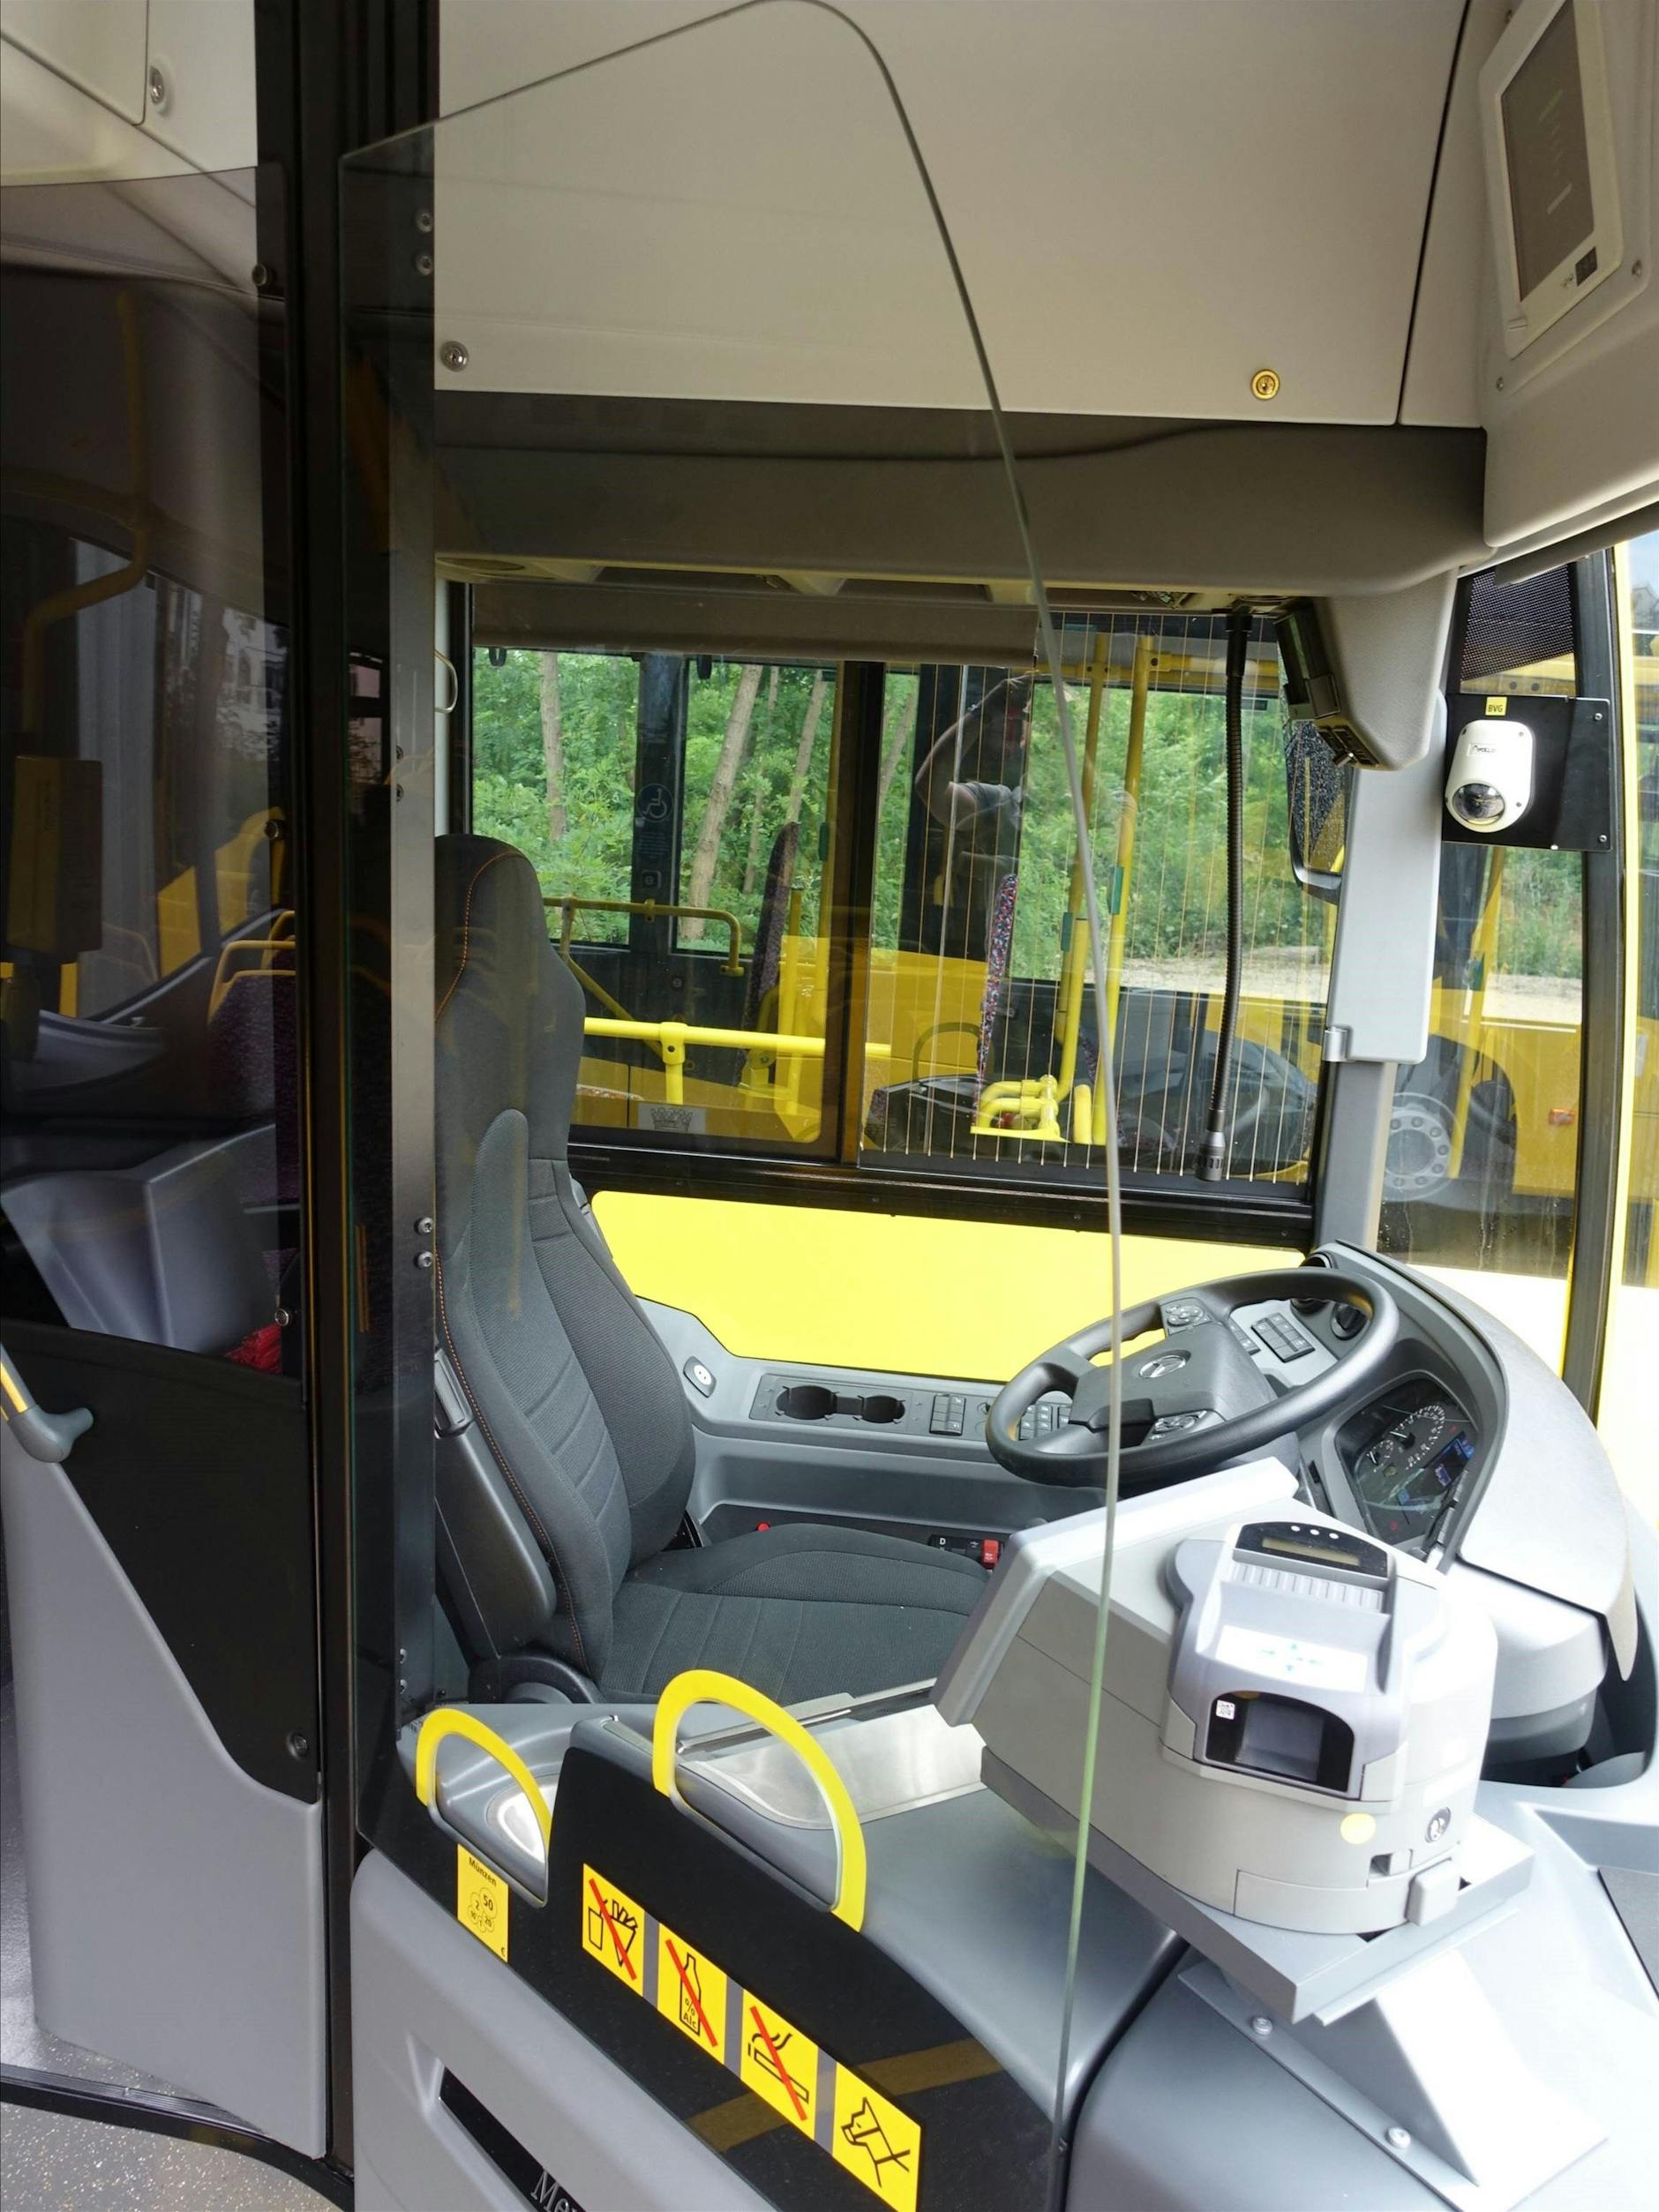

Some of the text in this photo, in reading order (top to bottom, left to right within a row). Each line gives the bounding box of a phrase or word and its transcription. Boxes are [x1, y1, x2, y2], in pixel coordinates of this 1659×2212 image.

[1488, 704, 1503, 713] BVG
[469, 1856, 497, 1887] Münzen
[483, 1893, 494, 1912] 50
[530, 2170, 577, 2212] Me
